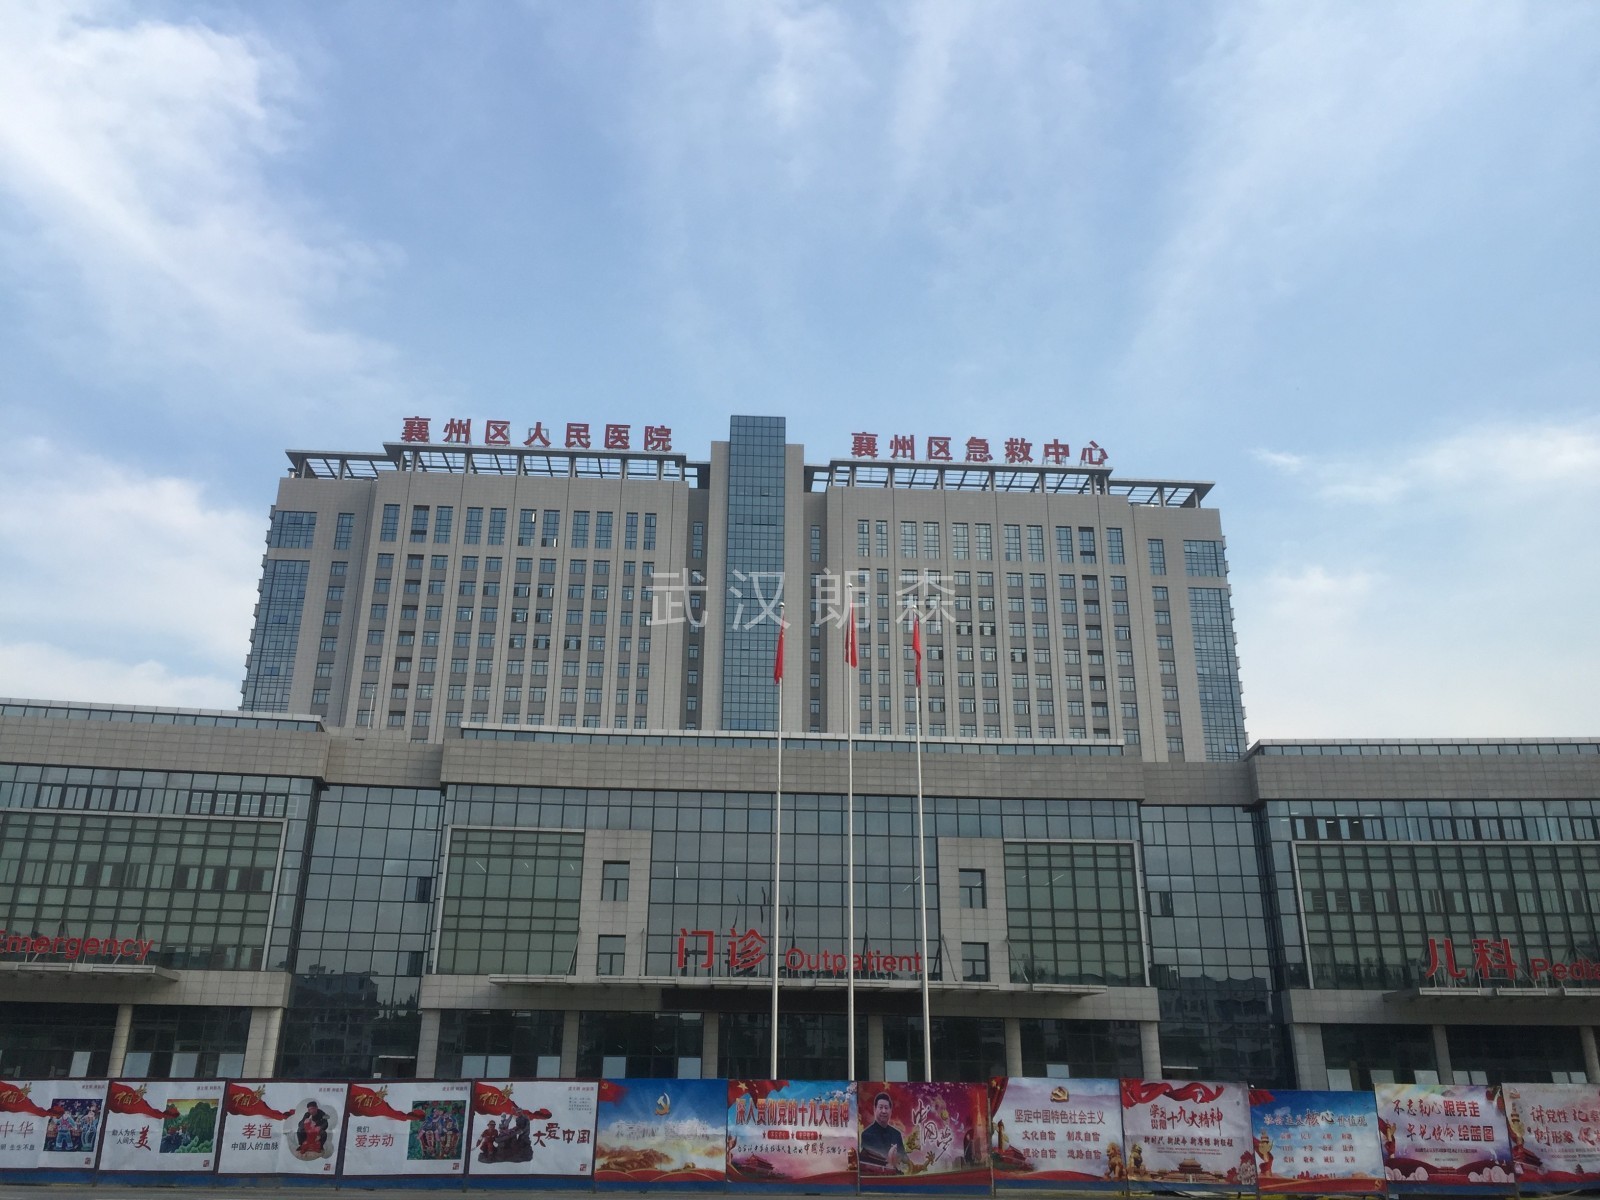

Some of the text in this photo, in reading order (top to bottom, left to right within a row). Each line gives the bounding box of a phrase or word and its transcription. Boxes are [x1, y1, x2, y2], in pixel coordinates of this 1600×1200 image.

[401, 416, 672, 451] 襄州区人民医院
[851, 432, 1108, 465] 襄州区急救中心
[677, 927, 767, 969] 门诊
[1425, 938, 1518, 980] 儿科
[785, 948, 922, 976] Outpatient
[735, 1098, 850, 1127] 深入贯彻党的十九大精神
[1015, 1109, 1105, 1125] 坚定中国特色社会主义
[1167, 1106, 1223, 1136] 十九大精神
[242, 1122, 273, 1139] 孝道
[355, 1134, 394, 1148] 爱劳动
[533, 1122, 591, 1147] 大爱中国
[1022, 1130, 1101, 1142] 文化自信 制度自信
[231, 1142, 279, 1151] 中国人的血脉
[1023, 1148, 1057, 1159] 理论自信
